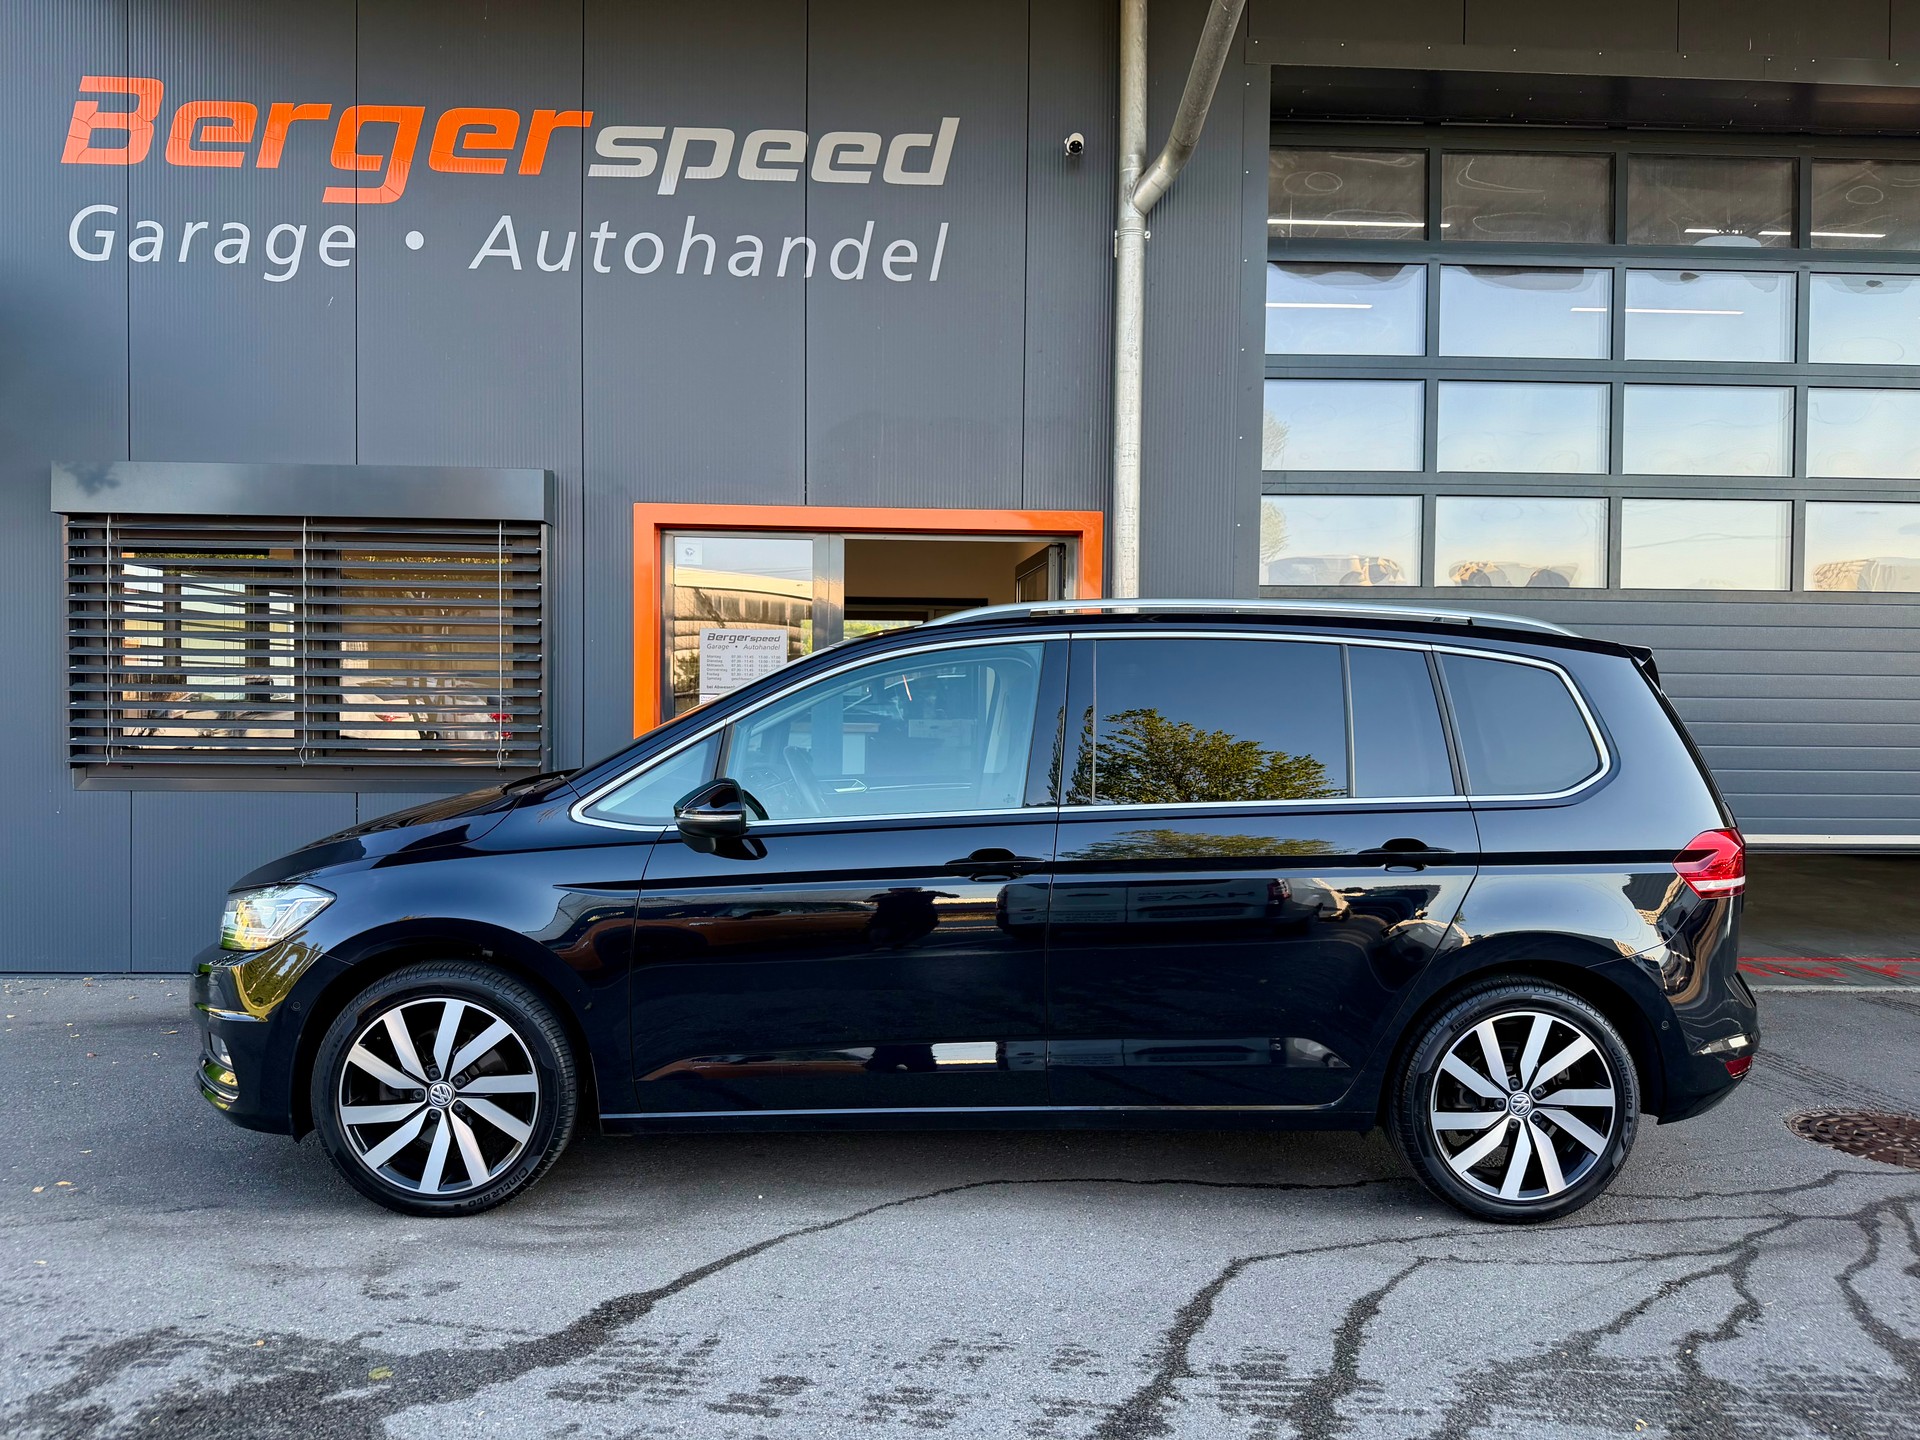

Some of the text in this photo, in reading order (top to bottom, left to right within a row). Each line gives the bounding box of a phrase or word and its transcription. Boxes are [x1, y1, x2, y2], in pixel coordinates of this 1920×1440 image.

[61, 76, 961, 205] Bergerspeed
[68, 204, 951, 283] Garage Autohandel
[707, 633, 780, 644] Bergerspeed
